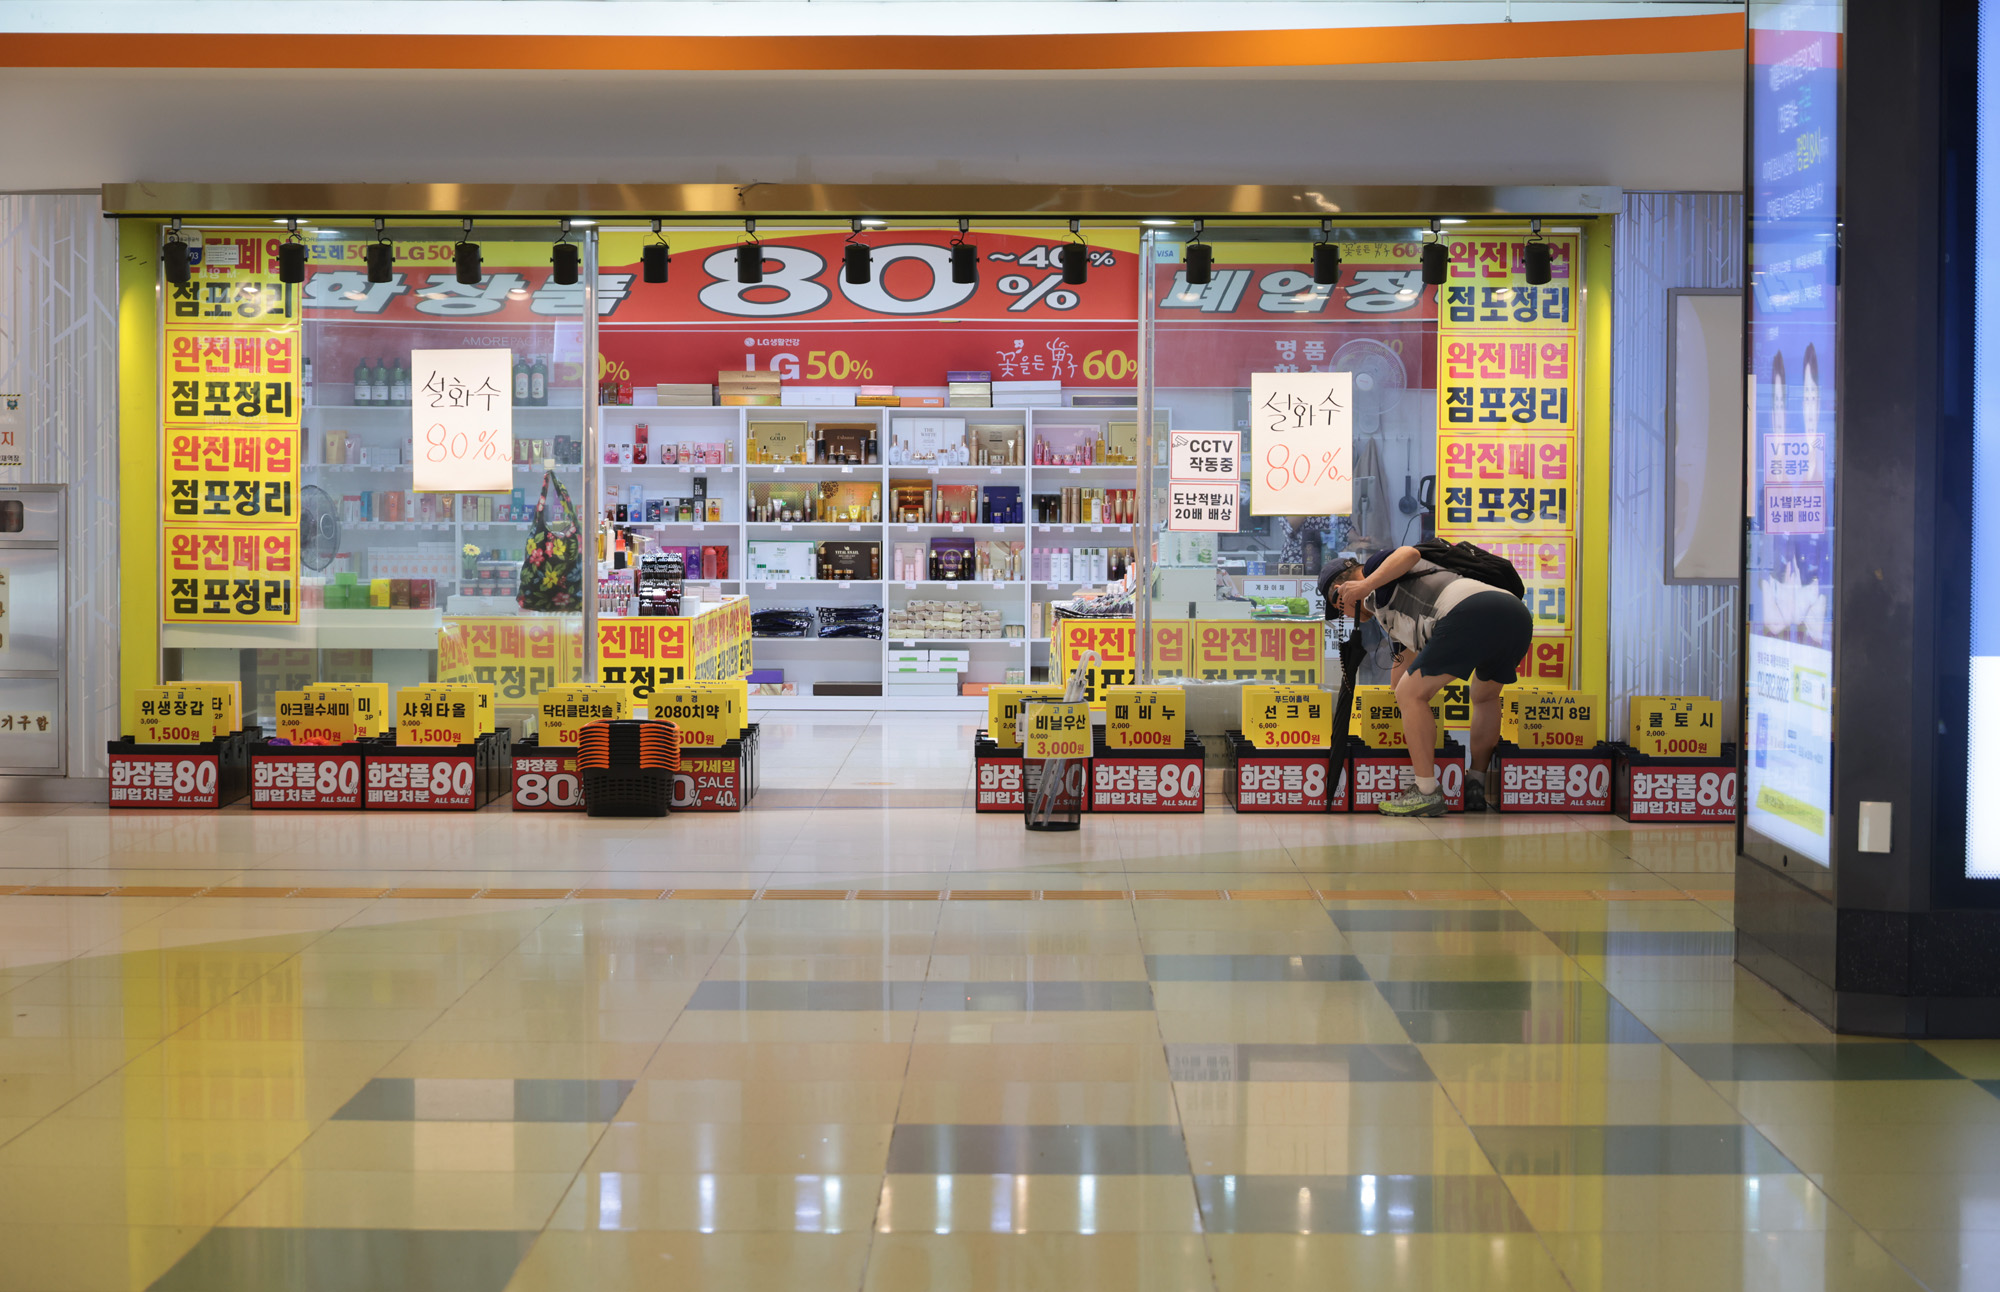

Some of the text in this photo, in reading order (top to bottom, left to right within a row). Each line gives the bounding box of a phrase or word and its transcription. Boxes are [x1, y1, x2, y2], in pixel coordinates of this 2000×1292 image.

[395, 246, 426, 260] LG
[172, 281, 292, 318] 점포정리
[1159, 269, 1440, 314] 폐업정
[1448, 286, 1569, 323] 점포정리
[757, 338, 800, 347] LG생활건강
[1275, 340, 1327, 361] 명품
[172, 337, 292, 373] 완전폐업
[1447, 342, 1568, 379] 완전폐업
[806, 350, 874, 380] 50%
[421, 370, 501, 411] 설화수
[171, 381, 292, 417] 점포정리
[1446, 387, 1568, 423] 점포정리
[1260, 388, 1344, 432] 설화수
[172, 436, 291, 472] 완전폐업
[1189, 440, 1233, 453] CCTV
[1189, 457, 1233, 472] 작동중
[1445, 443, 1567, 479] 완전폐업
[171, 480, 291, 516] 점포정리
[1173, 493, 1234, 506] 도난적발시
[1445, 487, 1566, 523] 점포정리
[1175, 508, 1232, 521] 20배 배상
[171, 535, 291, 571] 완전폐업
[171, 579, 291, 615] 점포정리
[460, 625, 554, 660] 전폐업
[598, 625, 684, 659] 전폐업
[1201, 628, 1317, 661] 완전폐업
[470, 666, 554, 699] 포정리
[162, 691, 185, 700] 고급
[303, 692, 325, 701] 고급
[424, 693, 447, 702] 고급
[566, 694, 589, 702] 고급
[676, 694, 698, 703] 애경
[1134, 695, 1157, 704] 고급
[141, 700, 204, 716] 위생장갑
[280, 702, 350, 717] 아크릴수세미
[403, 702, 466, 718] 샤워타올
[543, 703, 613, 719] 닥터클린칫솔
[655, 704, 720, 720] 2080치약
[1053, 706, 1074, 714] 고급
[1115, 704, 1176, 720] 때비누
[1264, 704, 1321, 719] 선크림
[1523, 706, 1564, 720] 건전지
[1569, 706, 1591, 720] 8입
[1670, 703, 1693, 711] 고급
[1, 716, 49, 731] 기구함
[1036, 714, 1086, 731] 비닐우산
[1371, 722, 1390, 730] 5,000
[1649, 712, 1714, 728] 쿨토시
[149, 726, 200, 742] 1,500원
[290, 728, 341, 743] 1,000원
[410, 729, 461, 744] 1,500원
[559, 730, 579, 743] 50
[679, 730, 715, 746] 500원
[1120, 731, 1172, 746] 1,000원
[1265, 730, 1321, 746] 3,000원
[1532, 731, 1584, 746] 1,500원
[1037, 741, 1085, 757] 3,000원
[1655, 738, 1708, 754] 1,000원
[515, 759, 558, 771] 화장품
[111, 760, 217, 794] 화장품 80%
[254, 760, 360, 795] 화장품 80%
[367, 761, 474, 796] 화장품 80%
[698, 776, 734, 788] SALE
[1095, 763, 1202, 798] 화장품 80%
[1240, 763, 1303, 790] 화장품
[1356, 763, 1416, 790] 화장품
[1503, 763, 1610, 798] 화장품 80%
[671, 773, 702, 807] 0%
[1633, 772, 1697, 799] 화장품
[111, 788, 173, 801] 폐업처분
[254, 789, 317, 802] 폐업처분
[367, 789, 430, 803] 폐업처분
[1095, 792, 1158, 805] 폐업처분
[1240, 792, 1303, 805] 폐업처분
[1503, 792, 1566, 805] 폐업처분
[1632, 801, 1697, 814] 폐업처분
